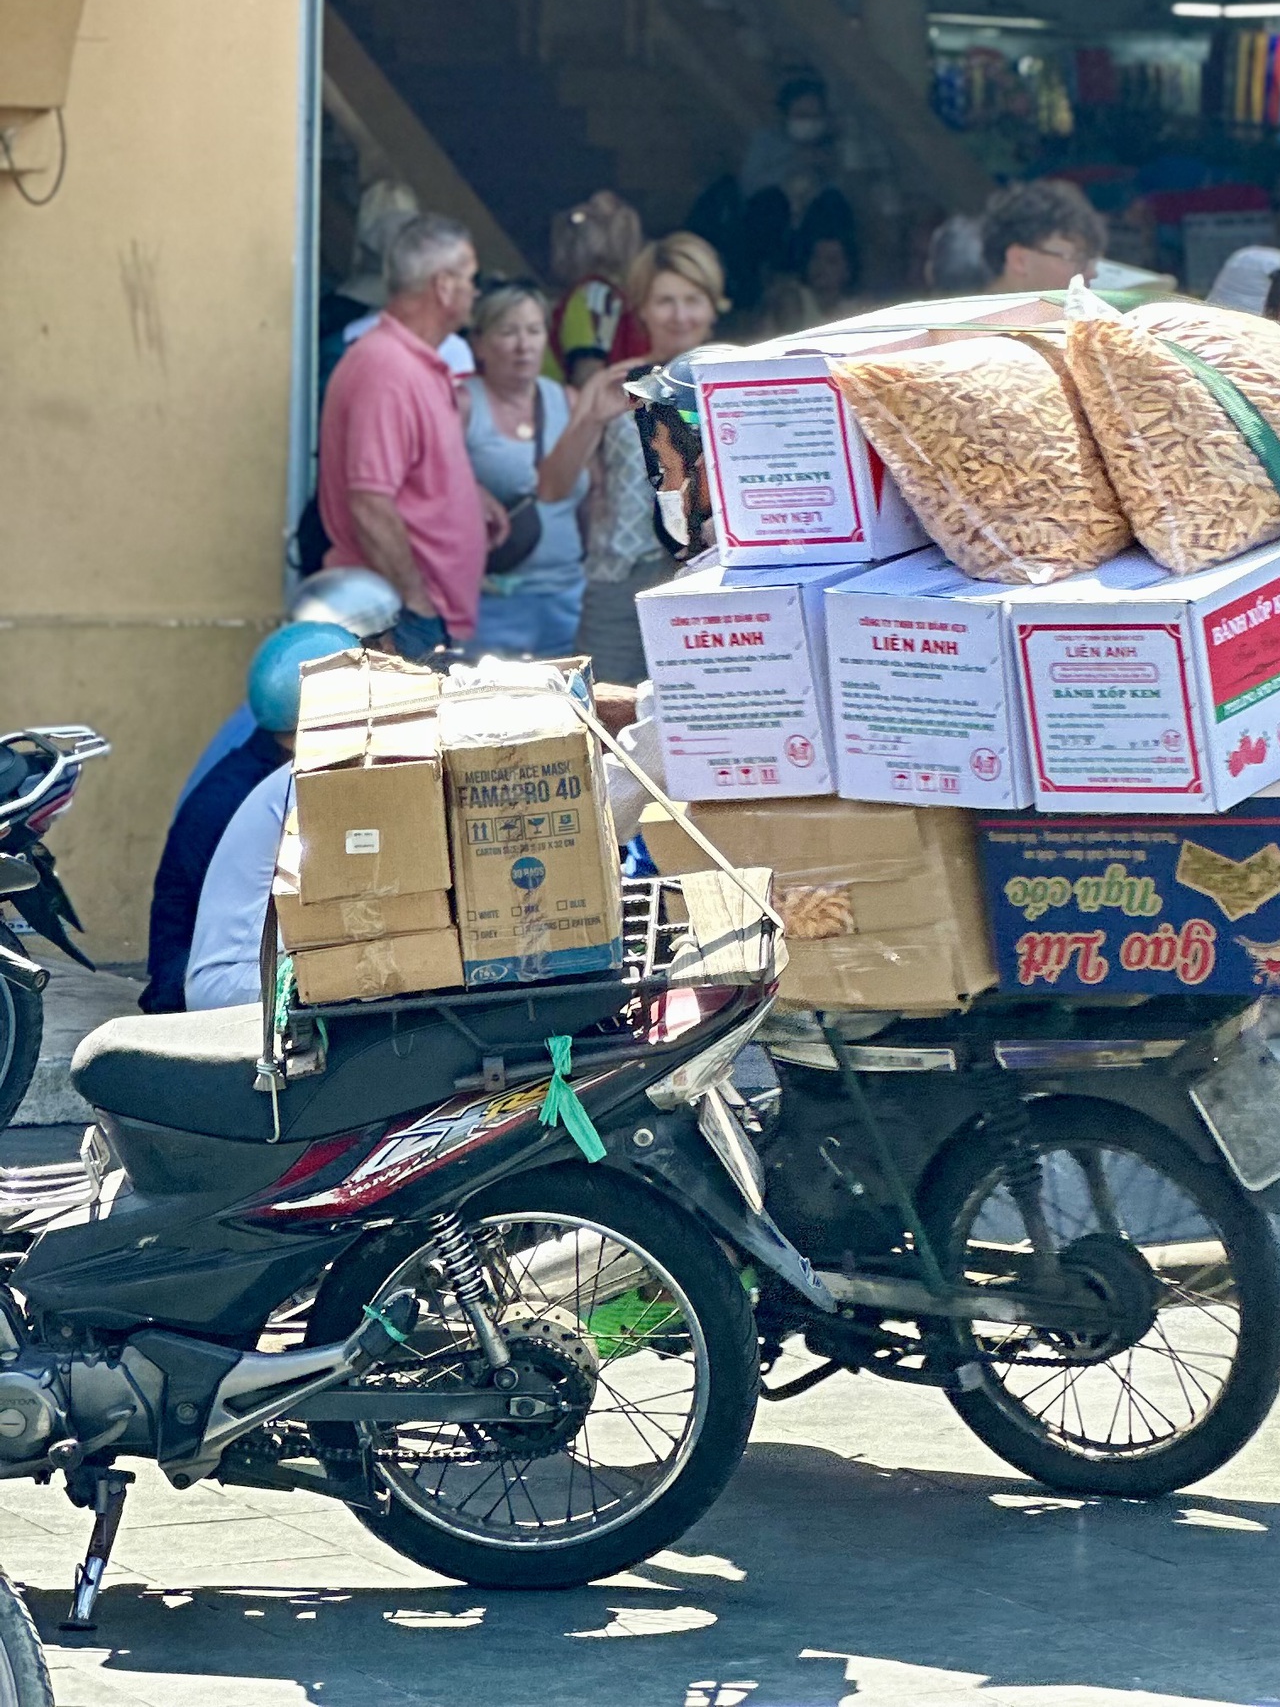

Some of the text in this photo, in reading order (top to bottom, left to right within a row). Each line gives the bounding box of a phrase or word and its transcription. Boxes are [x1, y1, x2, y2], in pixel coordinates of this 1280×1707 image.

[683, 630, 765, 649] LIÊN ANH
[872, 634, 959, 655] LIÊN ANH
[1065, 644, 1138, 658] LIÊN ANH
[541, 761, 571, 776] MASK
[556, 775, 581, 800] 4D
